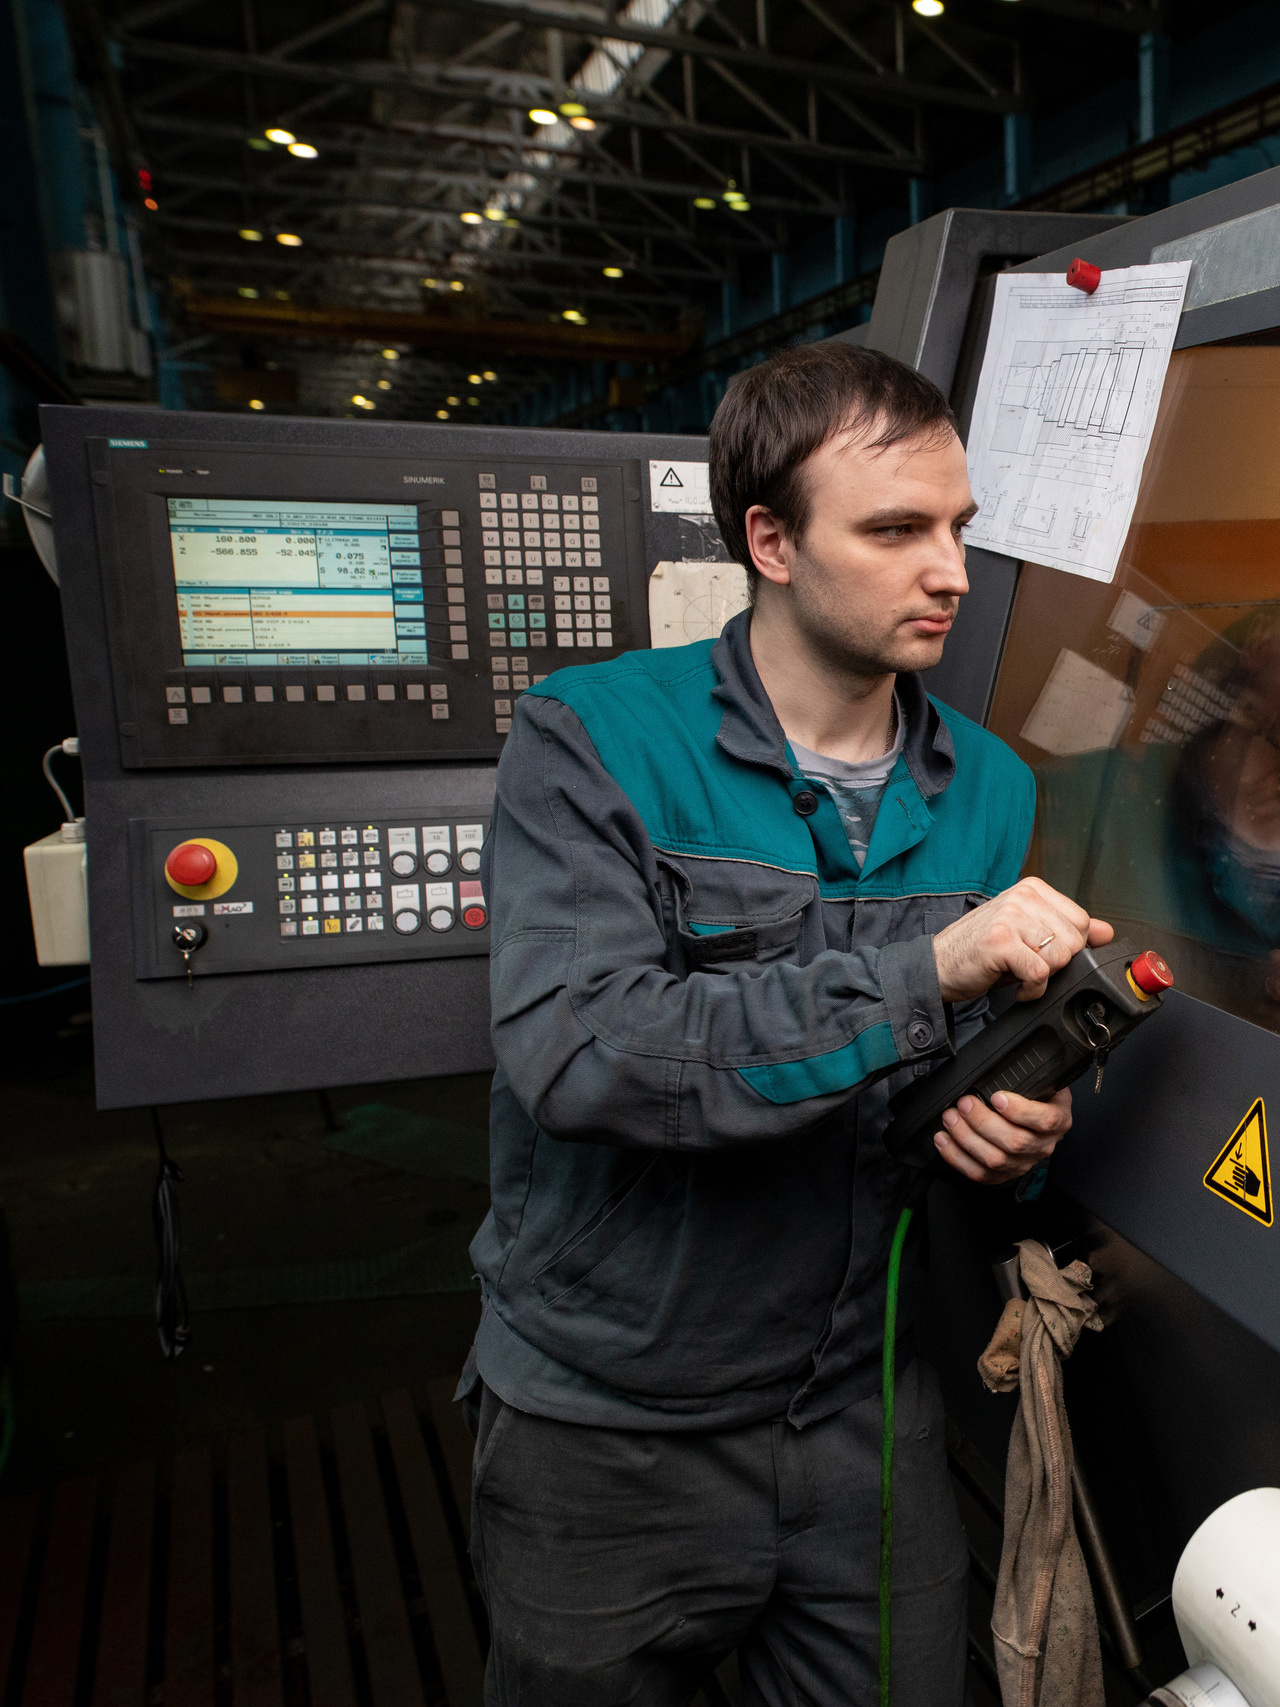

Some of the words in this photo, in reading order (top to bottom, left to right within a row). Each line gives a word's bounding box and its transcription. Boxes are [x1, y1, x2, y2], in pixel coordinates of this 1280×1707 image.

[109, 440, 146, 448] SIEMENS
[403, 476, 445, 484] SINUMERIK
[210, 548, 258, 556] -566.855
[337, 567, 365, 575] 98.82
